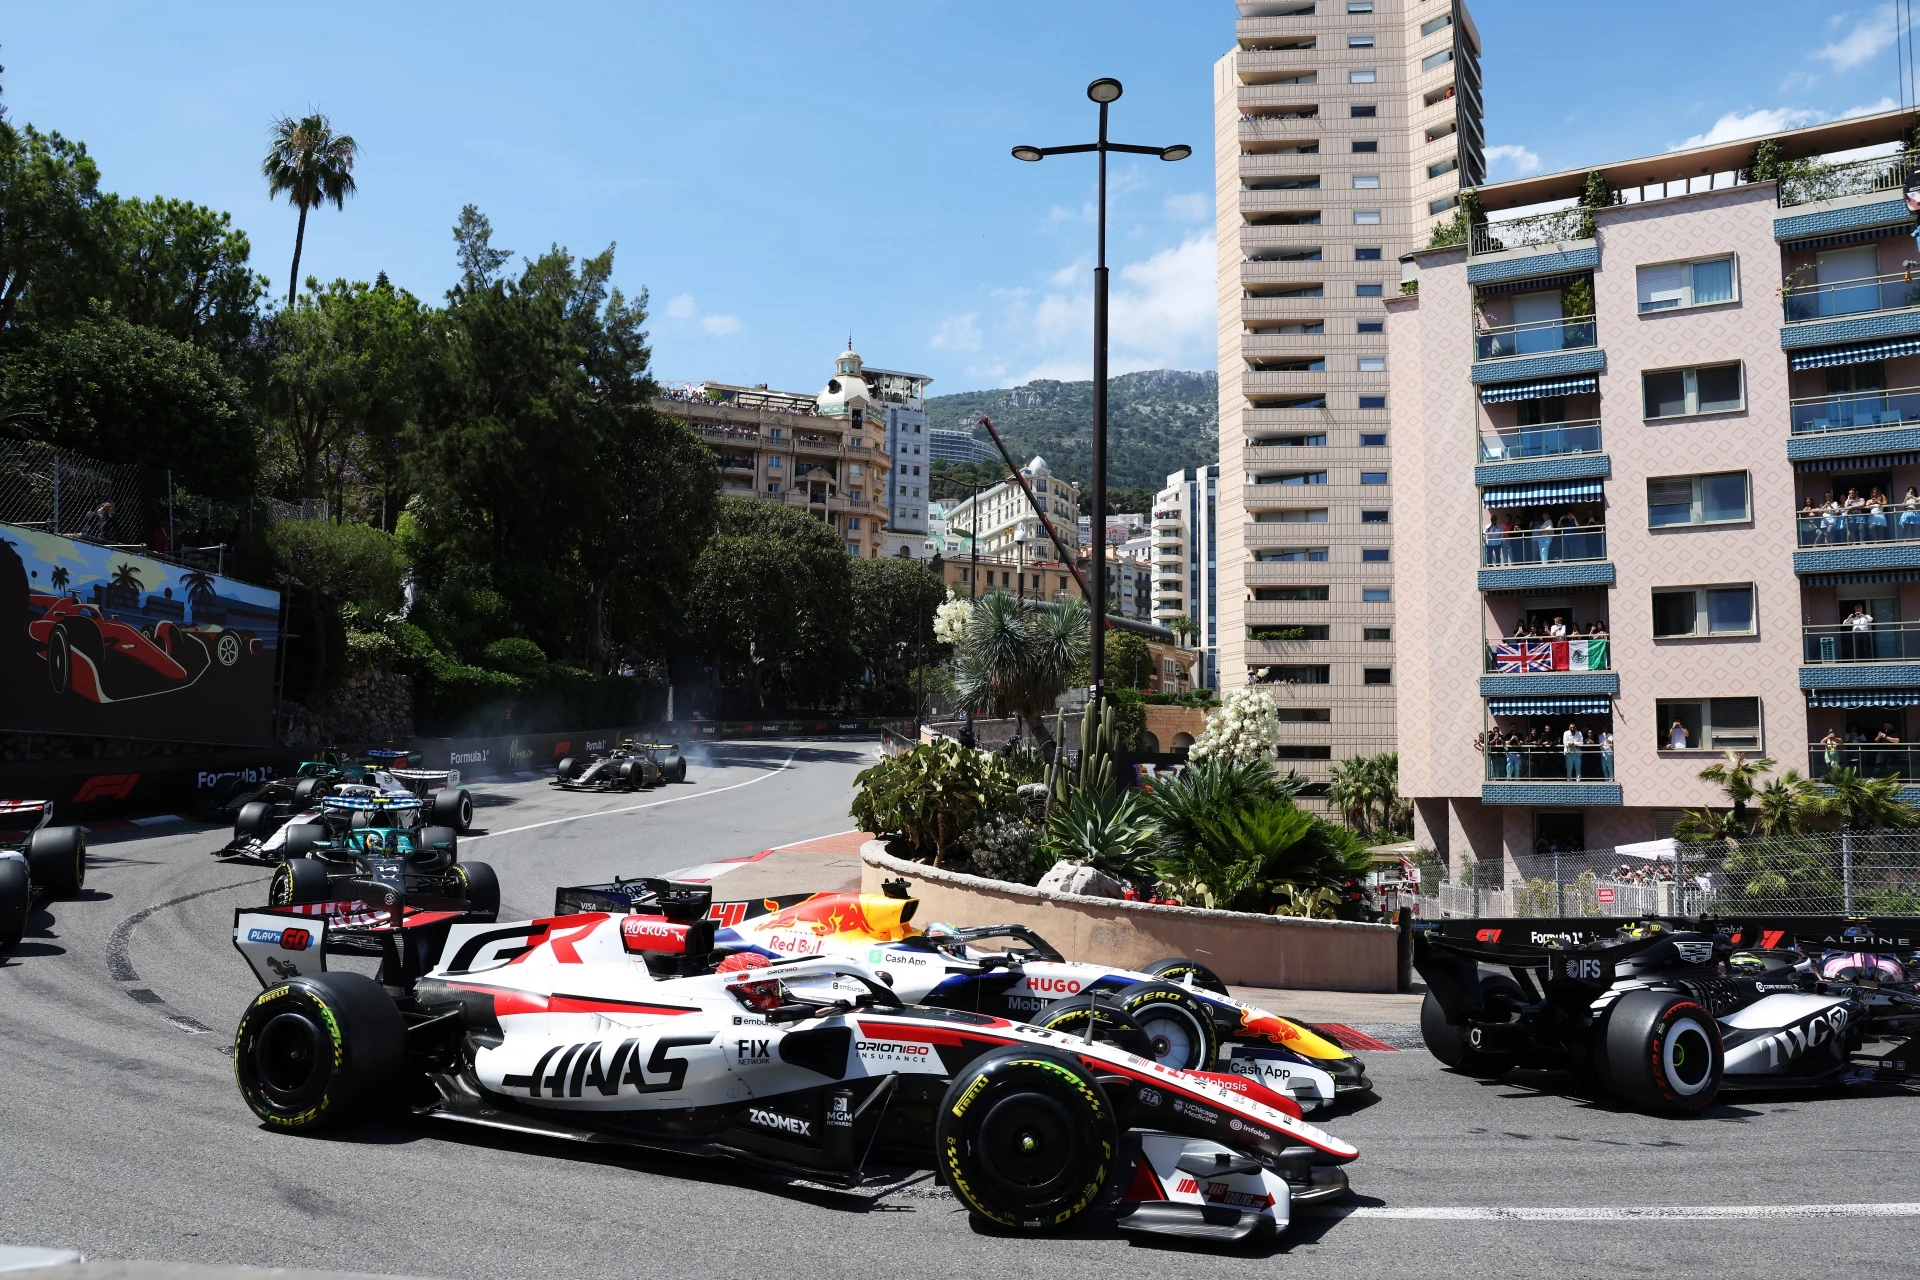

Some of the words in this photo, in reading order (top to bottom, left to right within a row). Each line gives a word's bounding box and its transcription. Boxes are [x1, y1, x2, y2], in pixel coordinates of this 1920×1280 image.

[450, 751, 481, 764] Formula
[580, 902, 597, 911] VISA
[709, 902, 749, 928] 41
[624, 923, 669, 937] RUCKUS
[281, 928, 310, 951] GO
[769, 935, 797, 952] Red
[1823, 936, 1910, 946] ALPINE
[885, 953, 907, 965] Cash
[908, 956, 927, 967] App
[1579, 959, 1601, 979] IFS
[839, 984, 865, 993] emburse
[1026, 976, 1081, 994] HUGO
[257, 985, 290, 1006] PIRELLI
[1008, 996, 1048, 1011] Mobil
[1132, 991, 1181, 1008] ZERO
[738, 1039, 770, 1058] FIX
[855, 1041, 929, 1056] ORION180
[502, 1031, 722, 1098] HAAS
[738, 1058, 771, 1066] NETWORK
[855, 1052, 927, 1063] INSURANCE
[1231, 1062, 1262, 1075] Cash
[1264, 1065, 1291, 1081] App
[952, 1074, 990, 1118] PIRELLI
[1139, 1089, 1161, 1105] FIA
[269, 1107, 318, 1127] ZERO
[826, 1111, 853, 1121] MGM
[1183, 1109, 1217, 1125] Medicine
[1185, 1103, 1219, 1119] UChicago
[749, 1108, 812, 1137] ZOOMEX
[826, 1120, 853, 1128] REWARDS
[1243, 1124, 1271, 1140] infobip
[1055, 1164, 1108, 1225] ZERO
